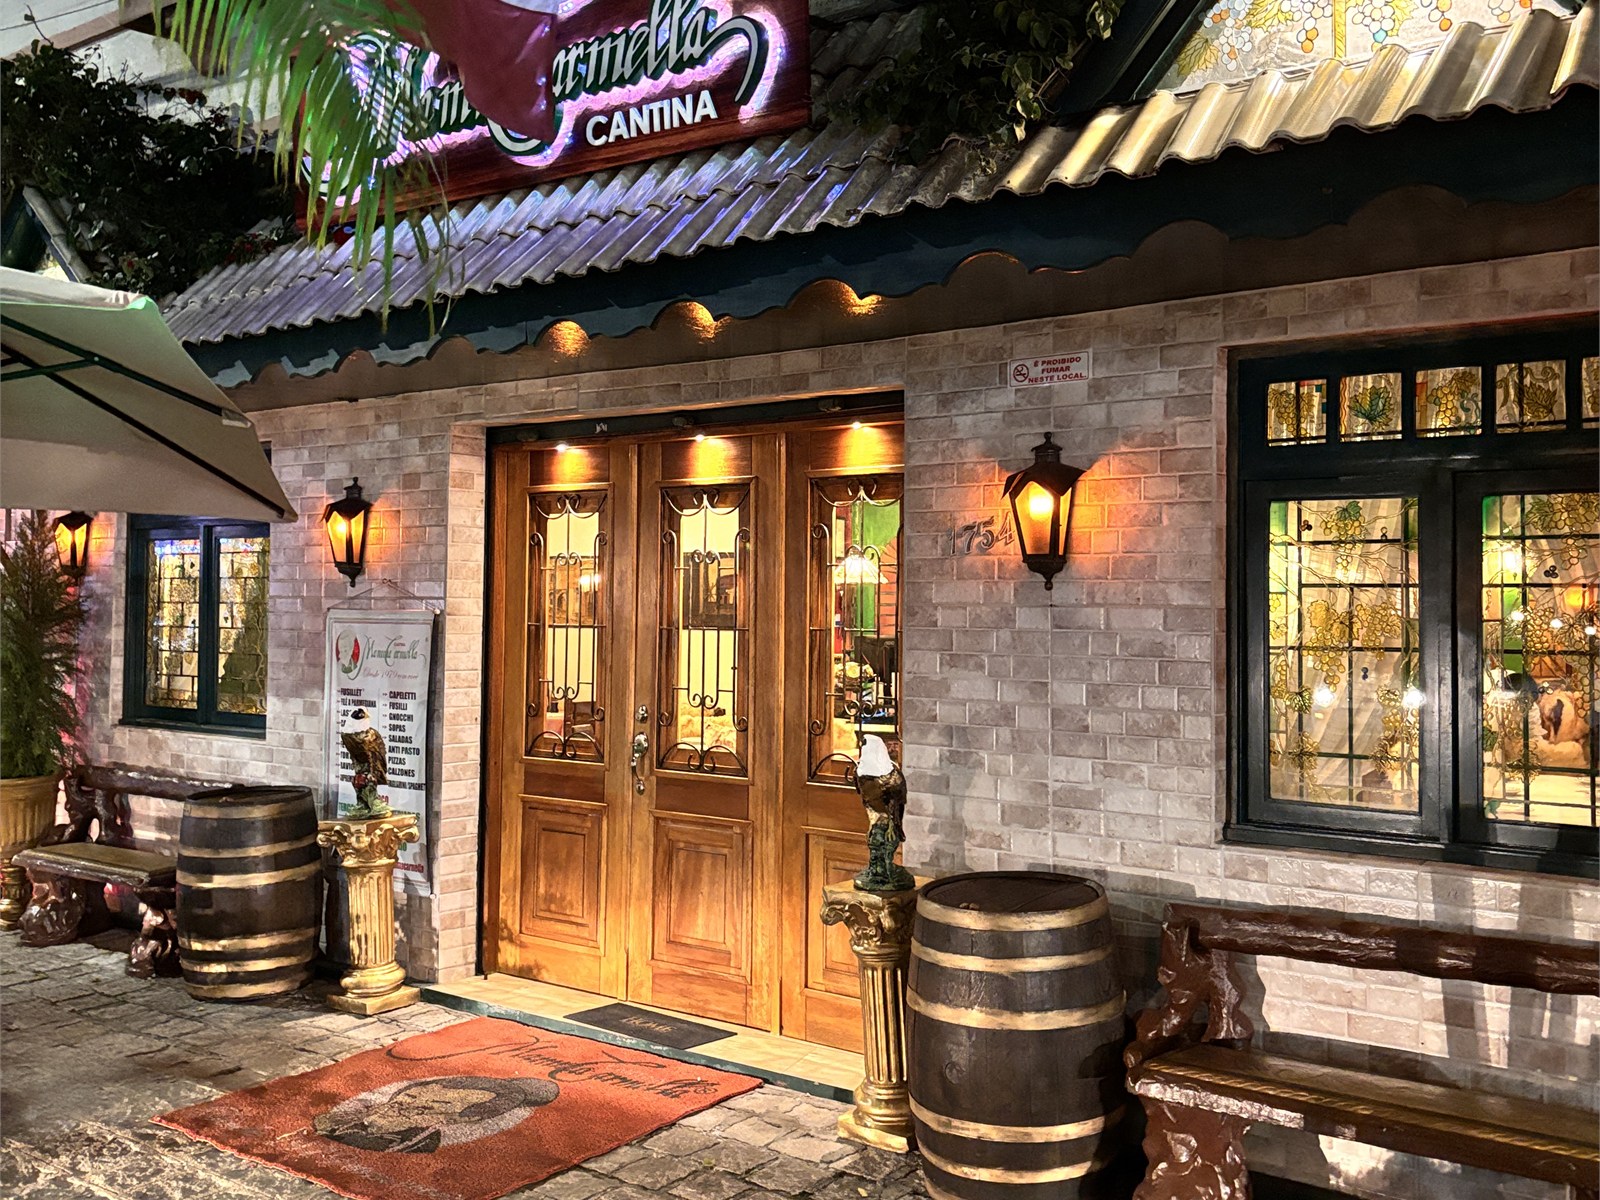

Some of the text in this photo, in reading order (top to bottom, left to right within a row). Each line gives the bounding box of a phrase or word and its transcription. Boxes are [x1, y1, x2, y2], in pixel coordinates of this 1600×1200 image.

[585, 89, 718, 147] CANTINA
[1041, 356, 1081, 366] PROIBIDO
[1041, 365, 1070, 374] FUMAR
[1028, 372, 1086, 383] NESTE LOCAL.
[947, 511, 1015, 556] 1754
[388, 691, 417, 700] CAPELETTI
[389, 702, 408, 711] FUSILLI
[389, 713, 414, 722] GNOCCHI
[388, 724, 406, 733] SOPAS
[388, 734, 413, 744] SALADAS
[388, 745, 420, 756] ANTI PASTO
[388, 756, 406, 766] PIZZAS
[387, 767, 415, 777] CALZONES
